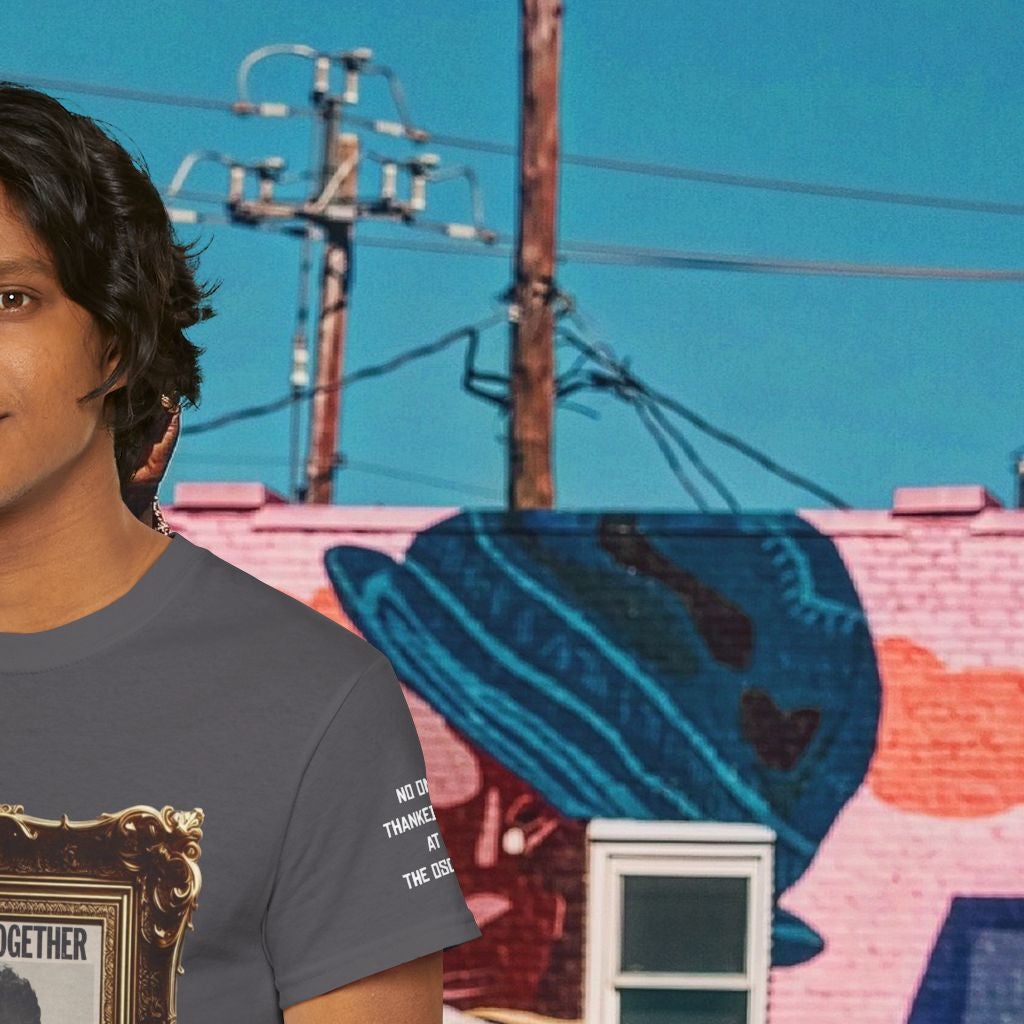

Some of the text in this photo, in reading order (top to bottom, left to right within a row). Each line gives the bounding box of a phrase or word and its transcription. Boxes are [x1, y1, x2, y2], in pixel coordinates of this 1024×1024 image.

[396, 784, 415, 803] NO
[427, 833, 440, 851] AT
[402, 867, 430, 889] THE
